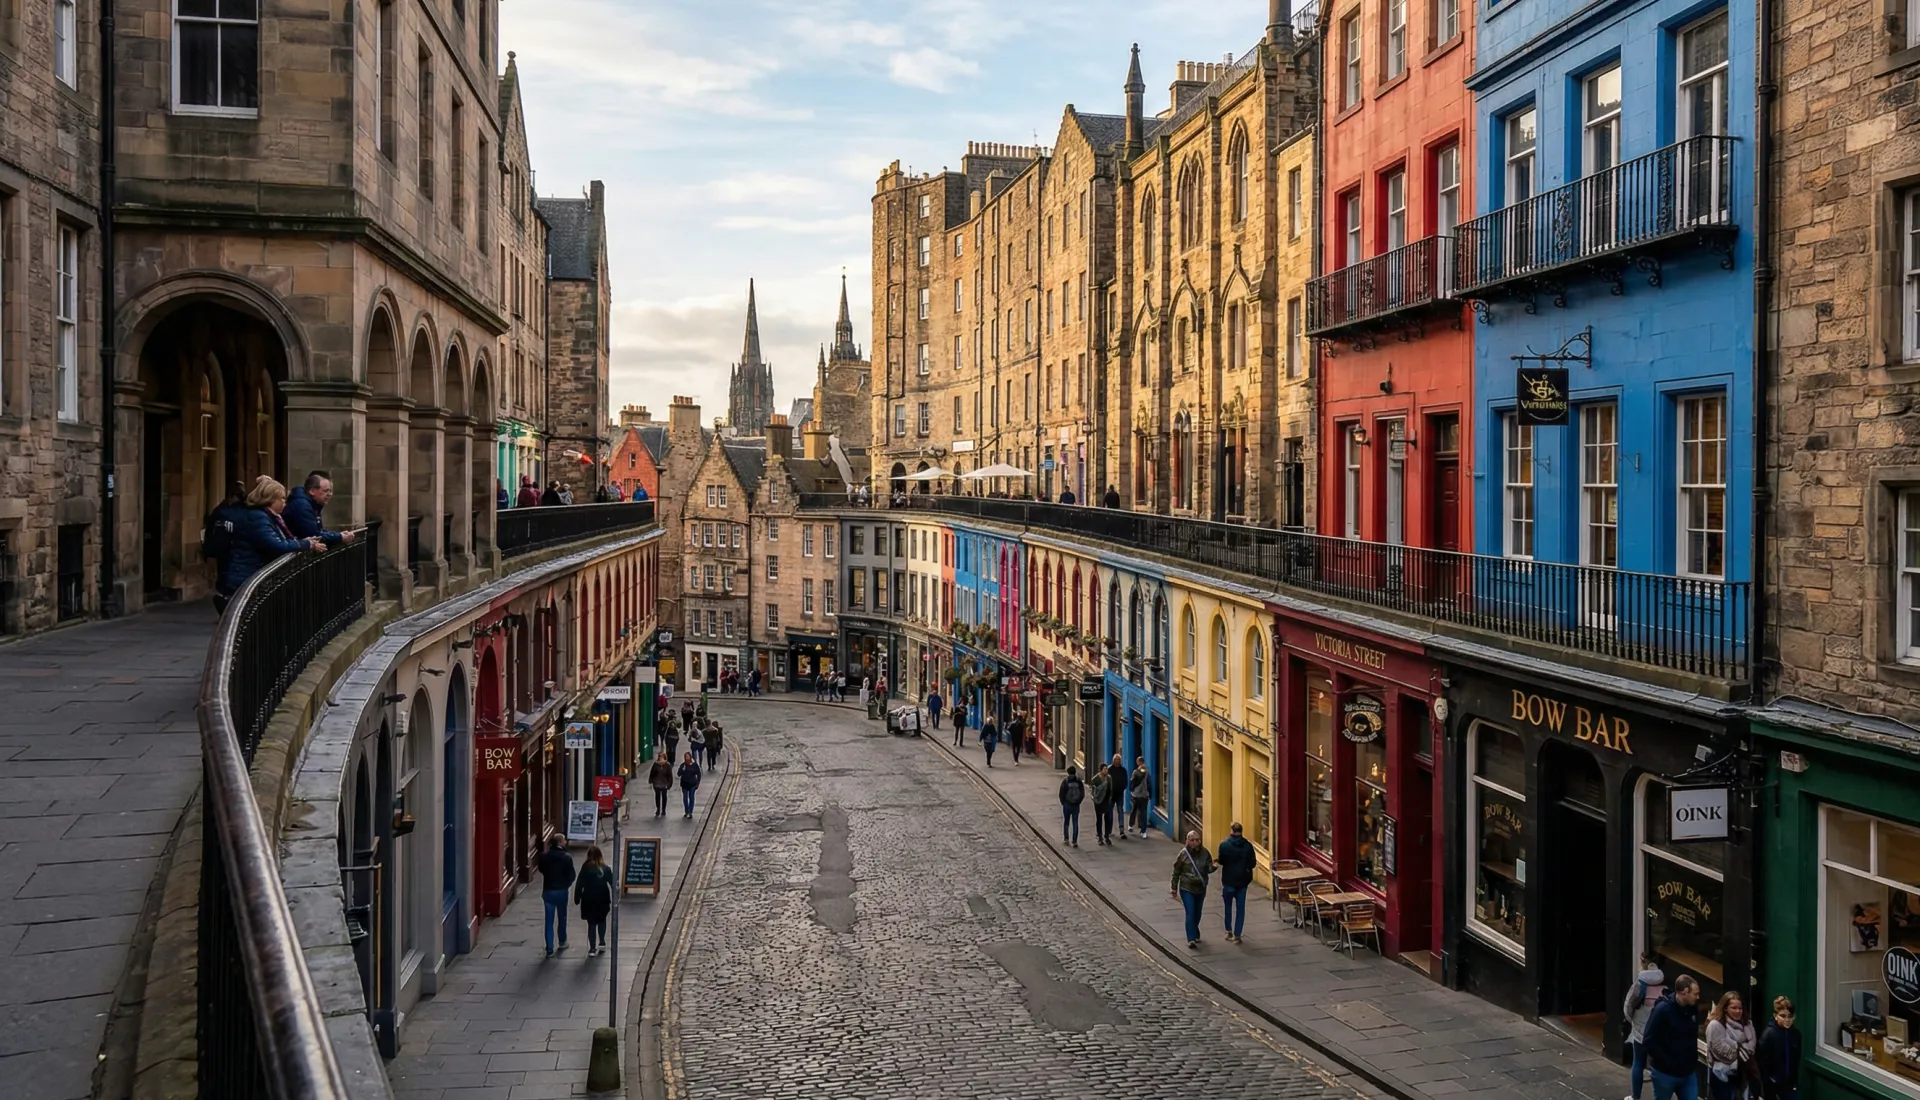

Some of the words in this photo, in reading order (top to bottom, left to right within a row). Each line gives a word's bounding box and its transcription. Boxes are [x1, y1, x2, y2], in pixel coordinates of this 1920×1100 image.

[1315, 632, 1351, 660] VICTORIA
[1354, 644, 1386, 670] STREET
[1511, 689, 1567, 734] BOW
[1574, 706, 1633, 754] BAR
[485, 747, 516, 759] BOW
[486, 759, 512, 770] BAR
[1675, 805, 1723, 823] OINK
[1657, 881, 1683, 899] BOW
[1686, 885, 1711, 921] BAR
[1887, 952, 1918, 985] OINK
